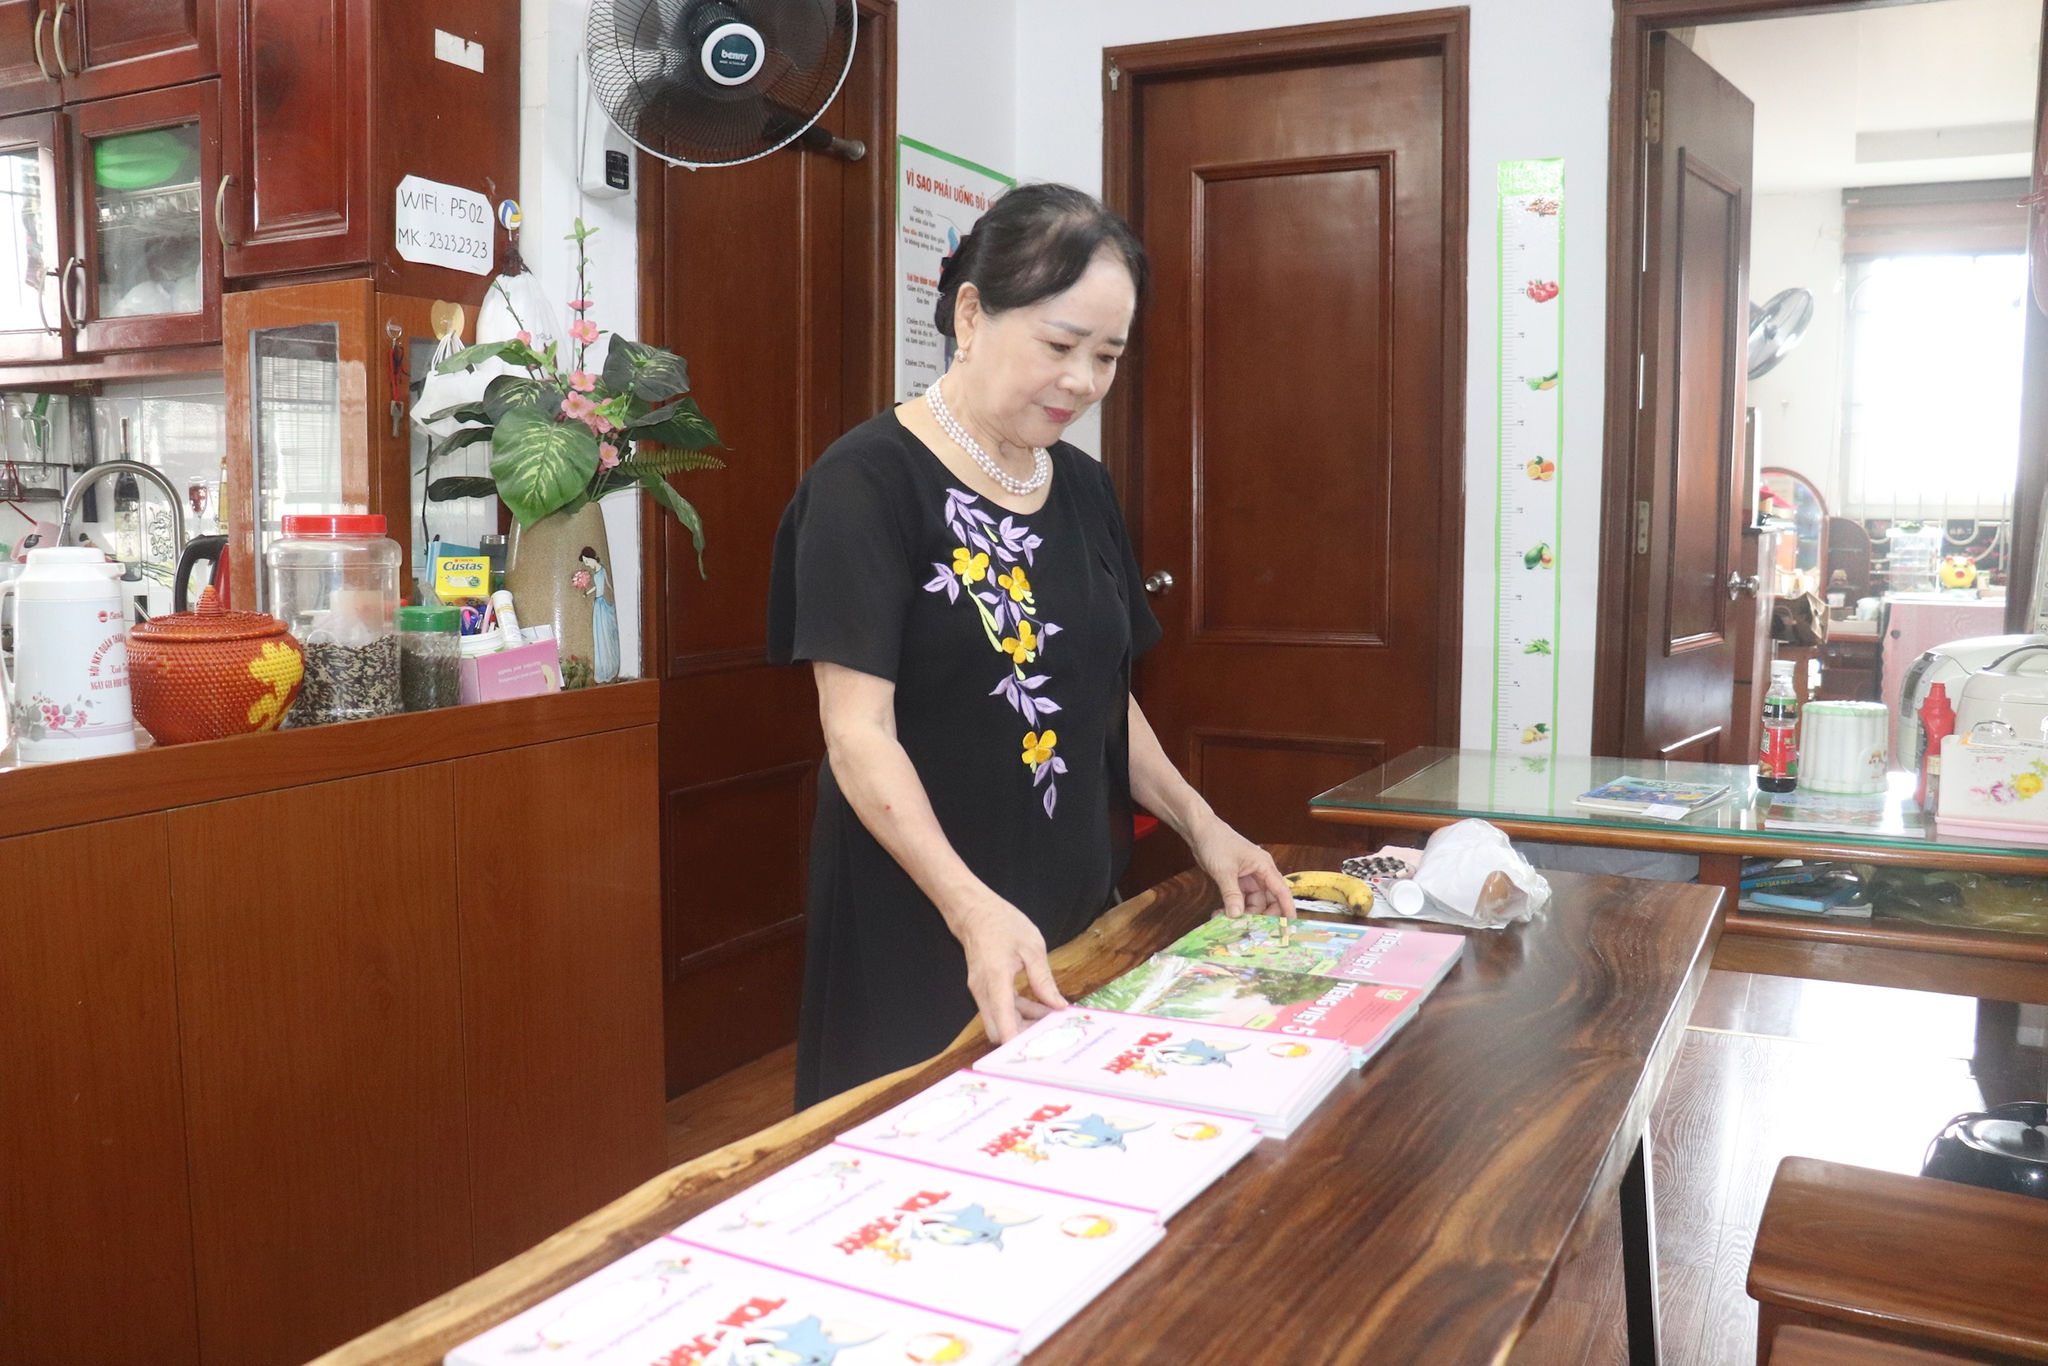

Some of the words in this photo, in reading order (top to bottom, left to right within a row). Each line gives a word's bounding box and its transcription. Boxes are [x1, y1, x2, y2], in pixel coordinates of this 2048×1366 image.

[906, 168, 914, 187] VÌ
[916, 174, 932, 192] SAO
[934, 178, 952, 200] PHẢI
[954, 184, 974, 207] UỐNG
[450, 197, 484, 224] P502
[429, 231, 488, 259] 23232323
[443, 561, 484, 571] Custas
[1368, 932, 1403, 952] TIẾNG
[1351, 951, 1381, 969] VIỆT
[1314, 981, 1359, 1007] TIẾNG
[1292, 1006, 1330, 1026] VIỆT
[1281, 1025, 1316, 1036] 5
